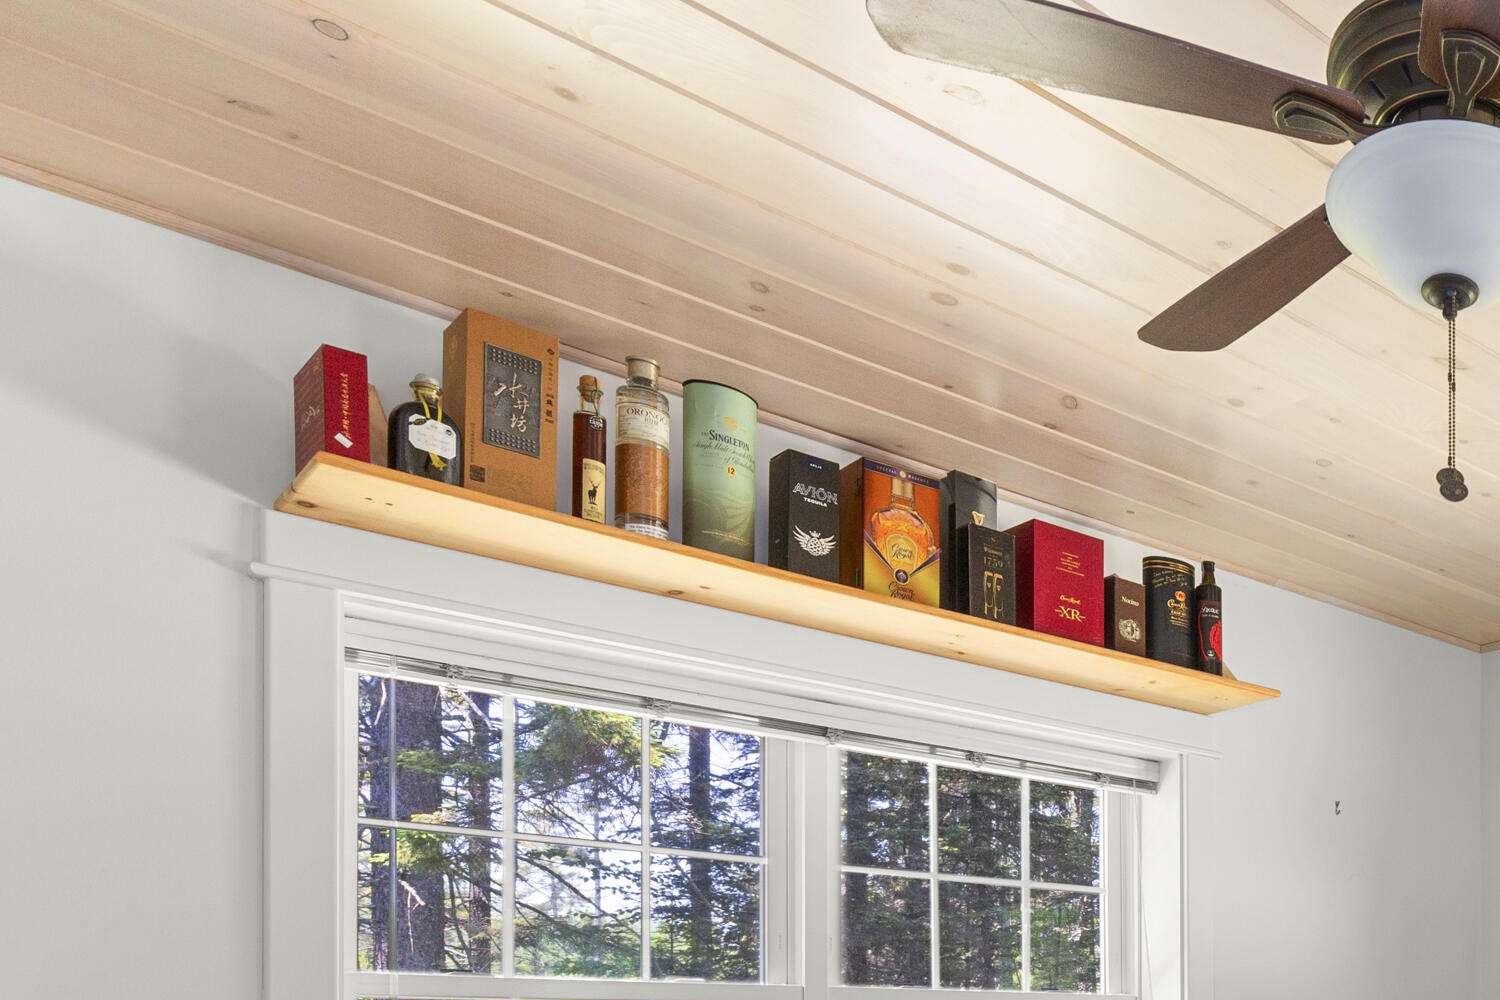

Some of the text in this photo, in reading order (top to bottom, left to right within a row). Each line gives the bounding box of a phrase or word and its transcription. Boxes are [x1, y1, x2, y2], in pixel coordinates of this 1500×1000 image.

[494, 372, 529, 433] 水井坊
[709, 429, 750, 452] SINGLETON
[727, 466, 736, 475] 12
[803, 496, 828, 508] TEQUILA
[1058, 605, 1082, 622] XR
